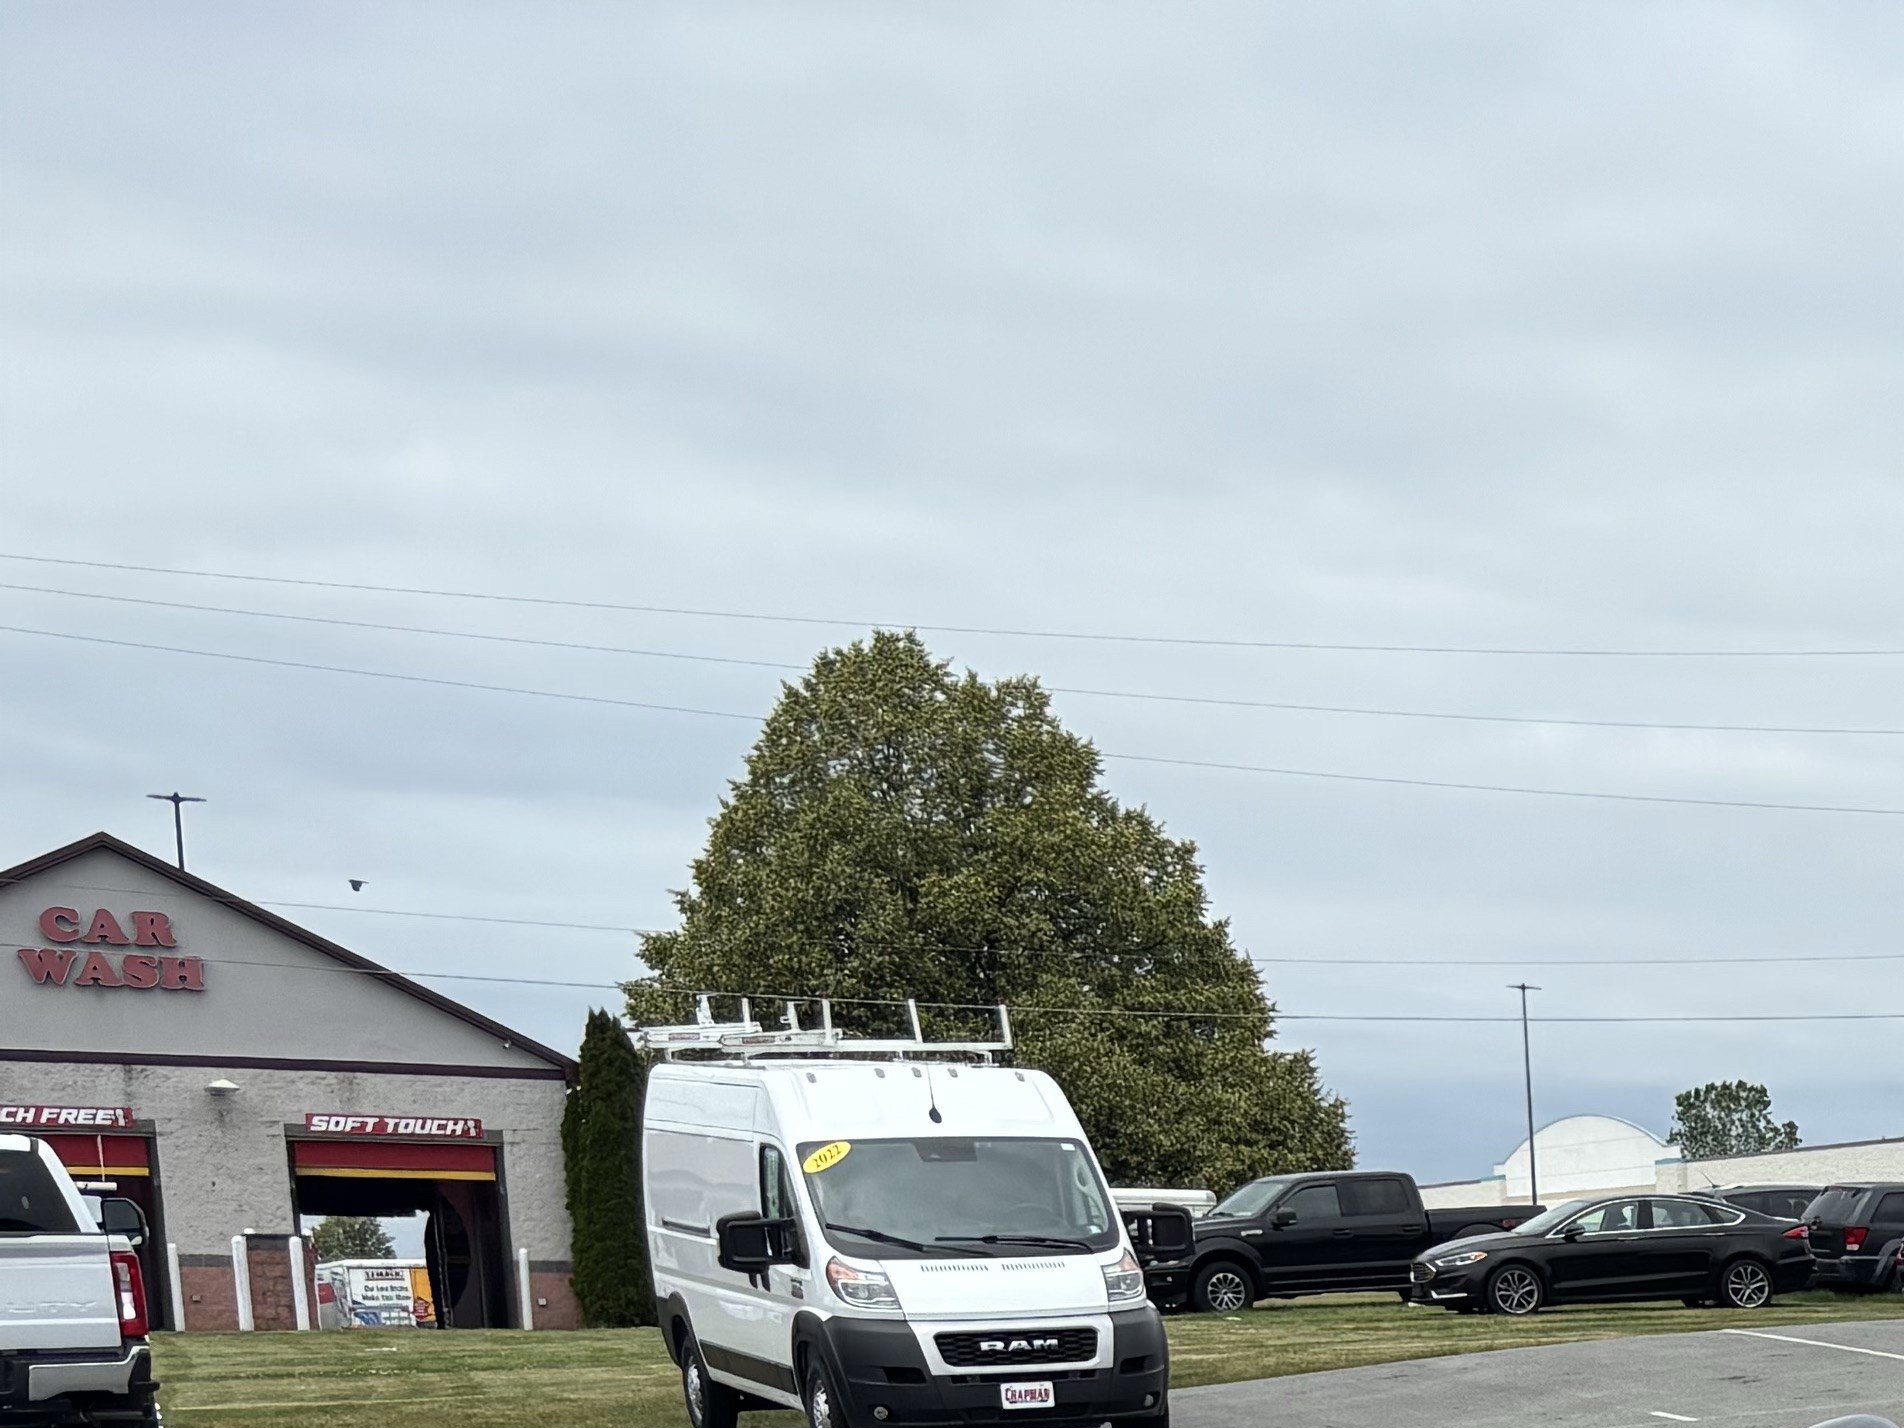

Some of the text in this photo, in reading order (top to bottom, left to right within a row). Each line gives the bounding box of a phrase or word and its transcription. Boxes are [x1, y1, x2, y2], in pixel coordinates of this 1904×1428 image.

[39, 906, 177, 947] CAR
[18, 948, 205, 991] WASH
[310, 1116, 464, 1136] SOFT TOUCH
[813, 1144, 842, 1169] 2022
[979, 1339, 1059, 1352] RAM
